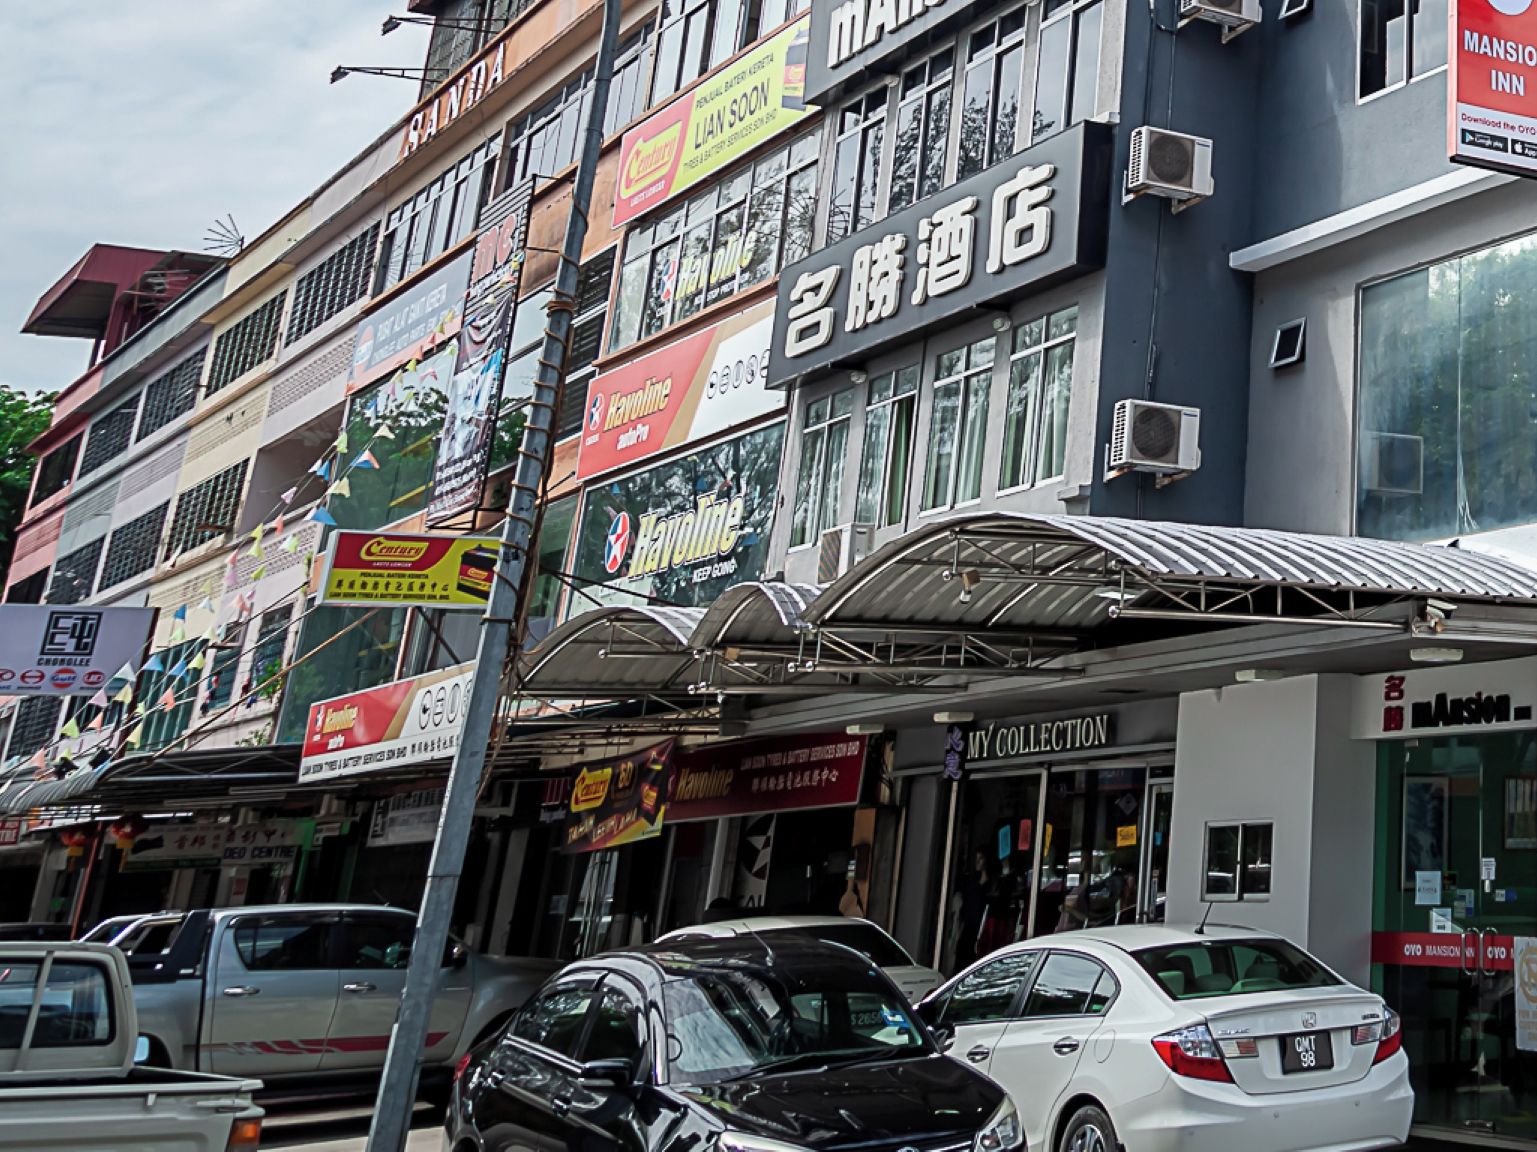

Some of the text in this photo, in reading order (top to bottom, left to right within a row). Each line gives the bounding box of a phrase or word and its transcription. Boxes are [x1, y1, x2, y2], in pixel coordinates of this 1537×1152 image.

[1491, 69, 1525, 97] INN
[694, 77, 771, 150] LIAN SOON
[1461, 113, 1502, 128] Download
[1503, 121, 1517, 132] the
[1518, 124, 1537, 136] OYO
[625, 134, 678, 192] Century
[784, 163, 1056, 359] 名勝酒店
[603, 375, 673, 433] Havoline
[364, 537, 424, 560] Century
[628, 490, 744, 581] Havoline
[967, 714, 1109, 760] MY COLLECTION
[675, 764, 735, 799] Havoline
[1404, 944, 1422, 957] OYO
[1425, 944, 1461, 958] MANSION
[1487, 946, 1506, 959] OYO
[1300, 1051, 1316, 1067] 98
